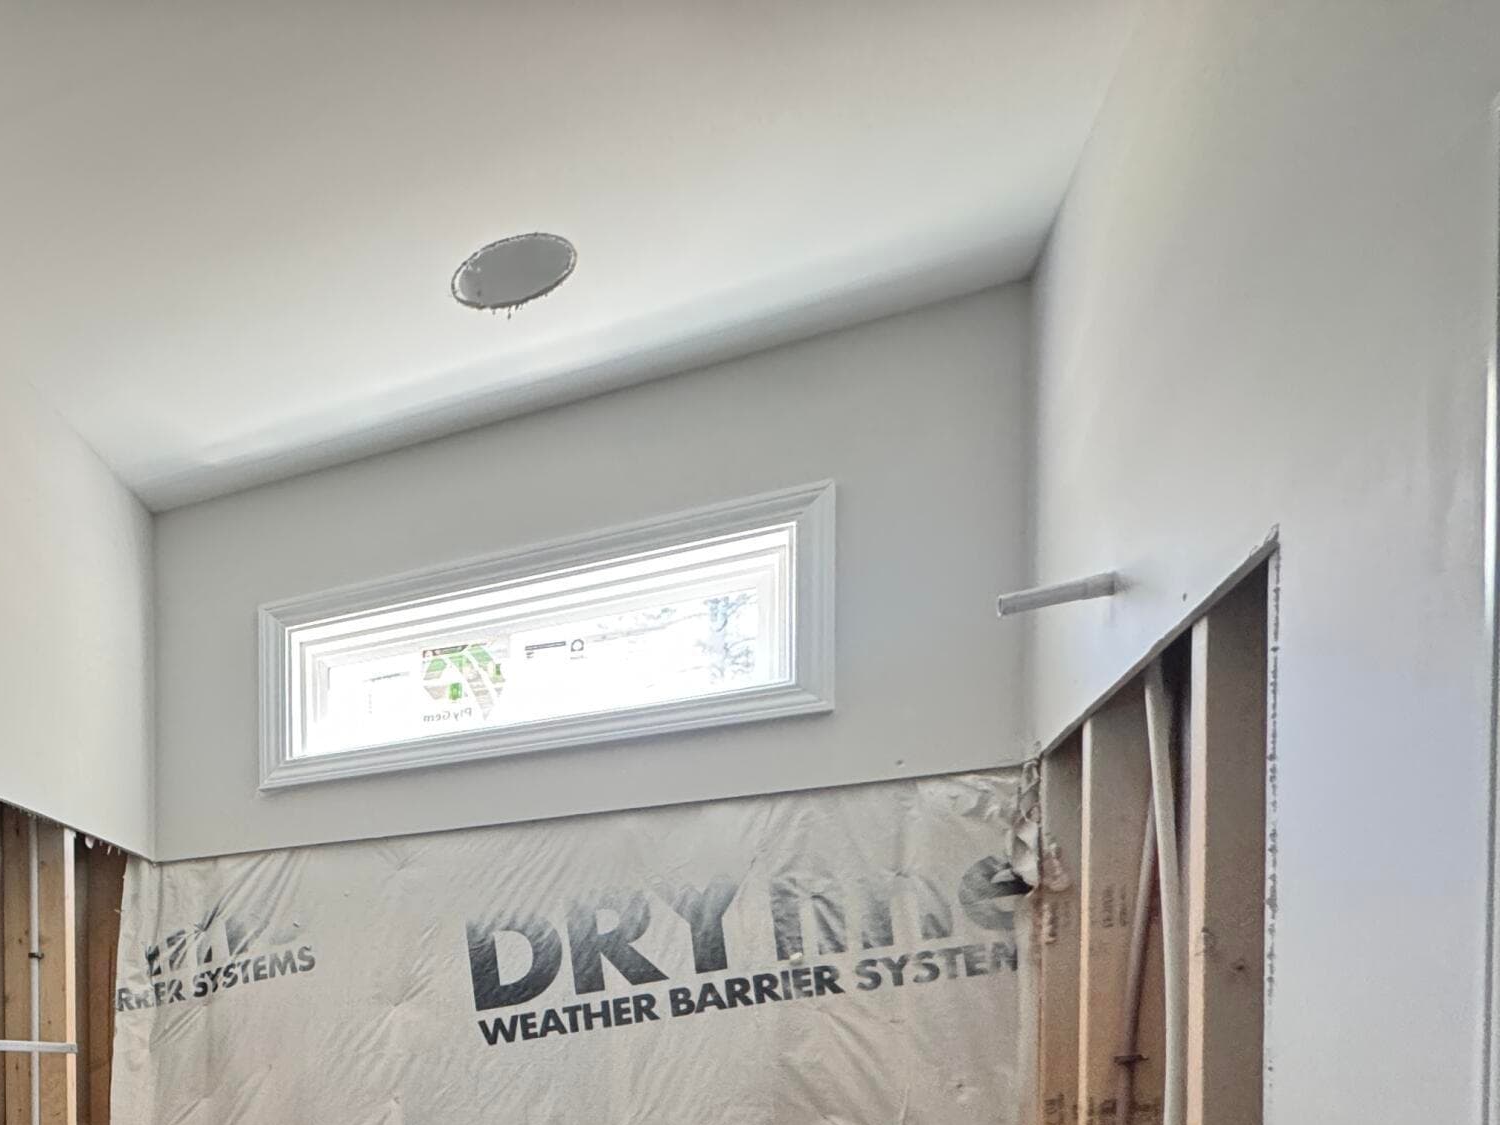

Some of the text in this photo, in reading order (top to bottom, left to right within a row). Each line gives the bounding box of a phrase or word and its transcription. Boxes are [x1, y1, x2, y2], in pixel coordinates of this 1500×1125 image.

[192, 945, 317, 998] SYSTEMS
[477, 993, 661, 1046] WEATHER
[668, 964, 846, 1018] BARRIER
